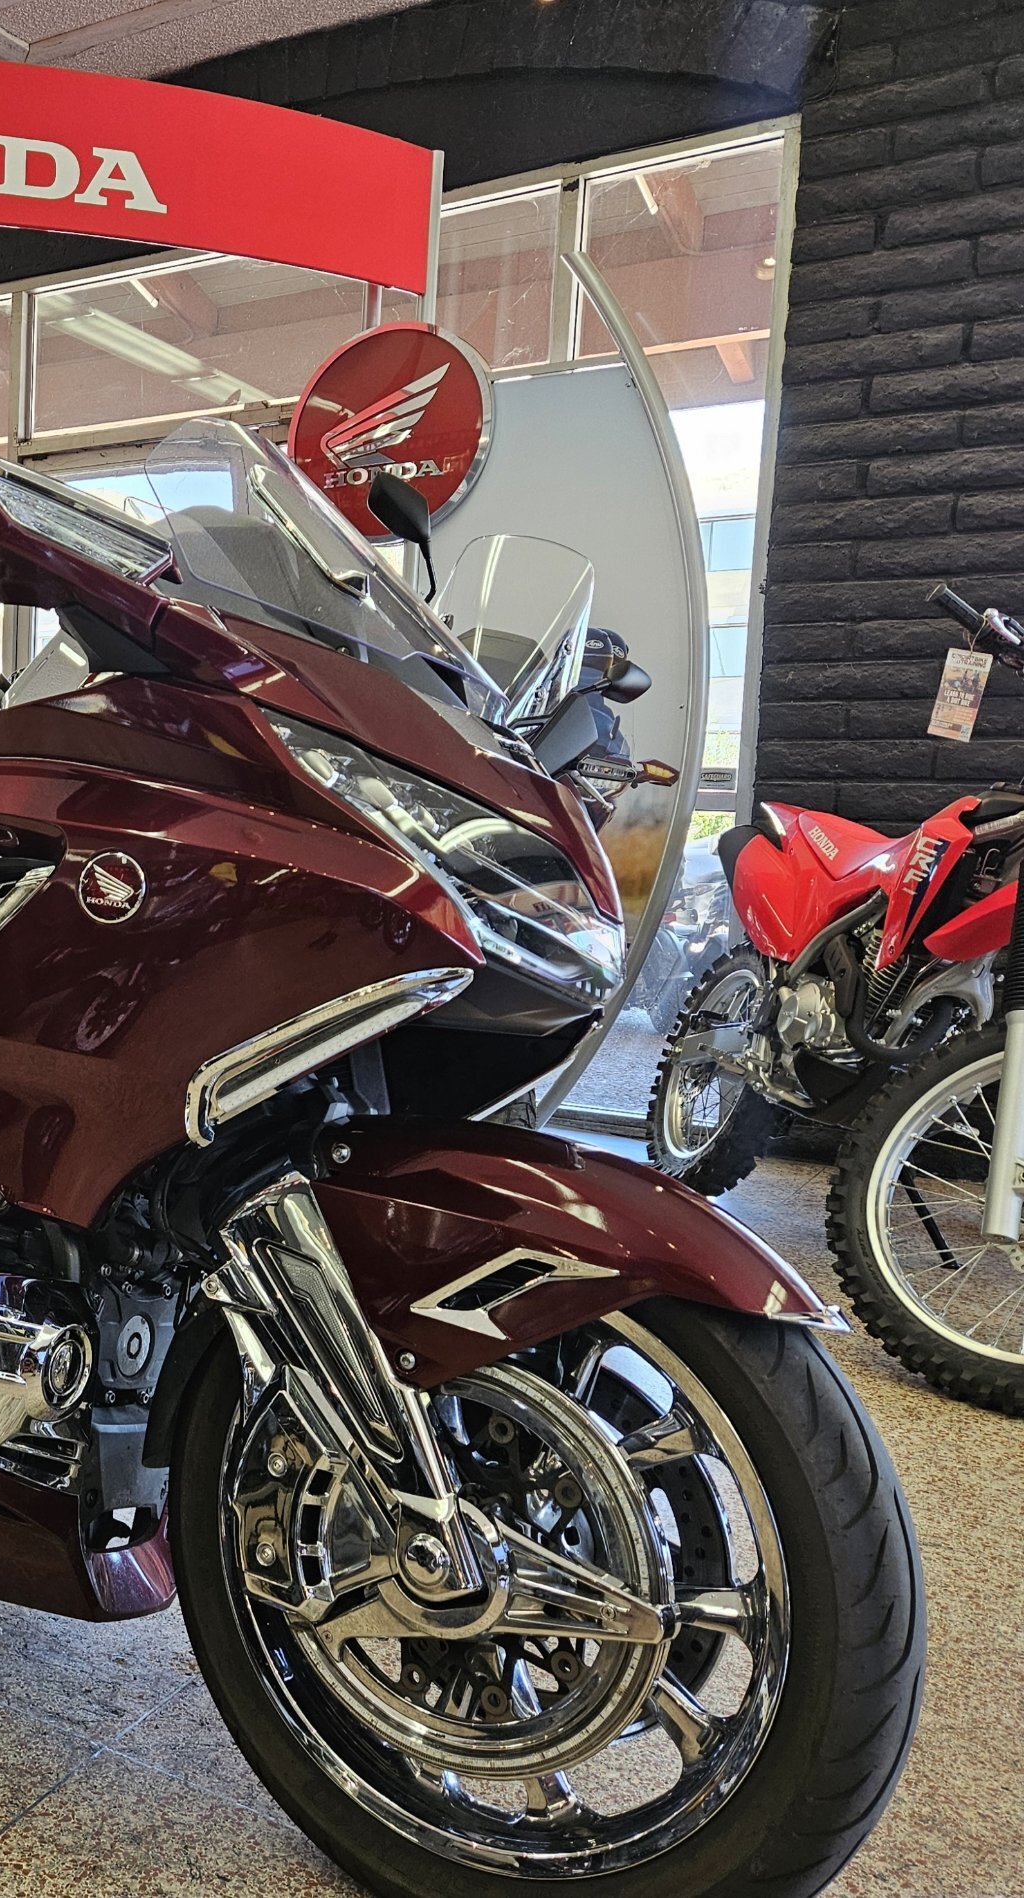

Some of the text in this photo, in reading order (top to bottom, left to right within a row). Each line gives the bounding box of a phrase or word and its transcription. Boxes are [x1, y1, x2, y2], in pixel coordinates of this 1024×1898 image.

[808, 825, 840, 862] HONDA
[902, 835, 943, 883] CRF
[86, 896, 131, 910] HONDA
